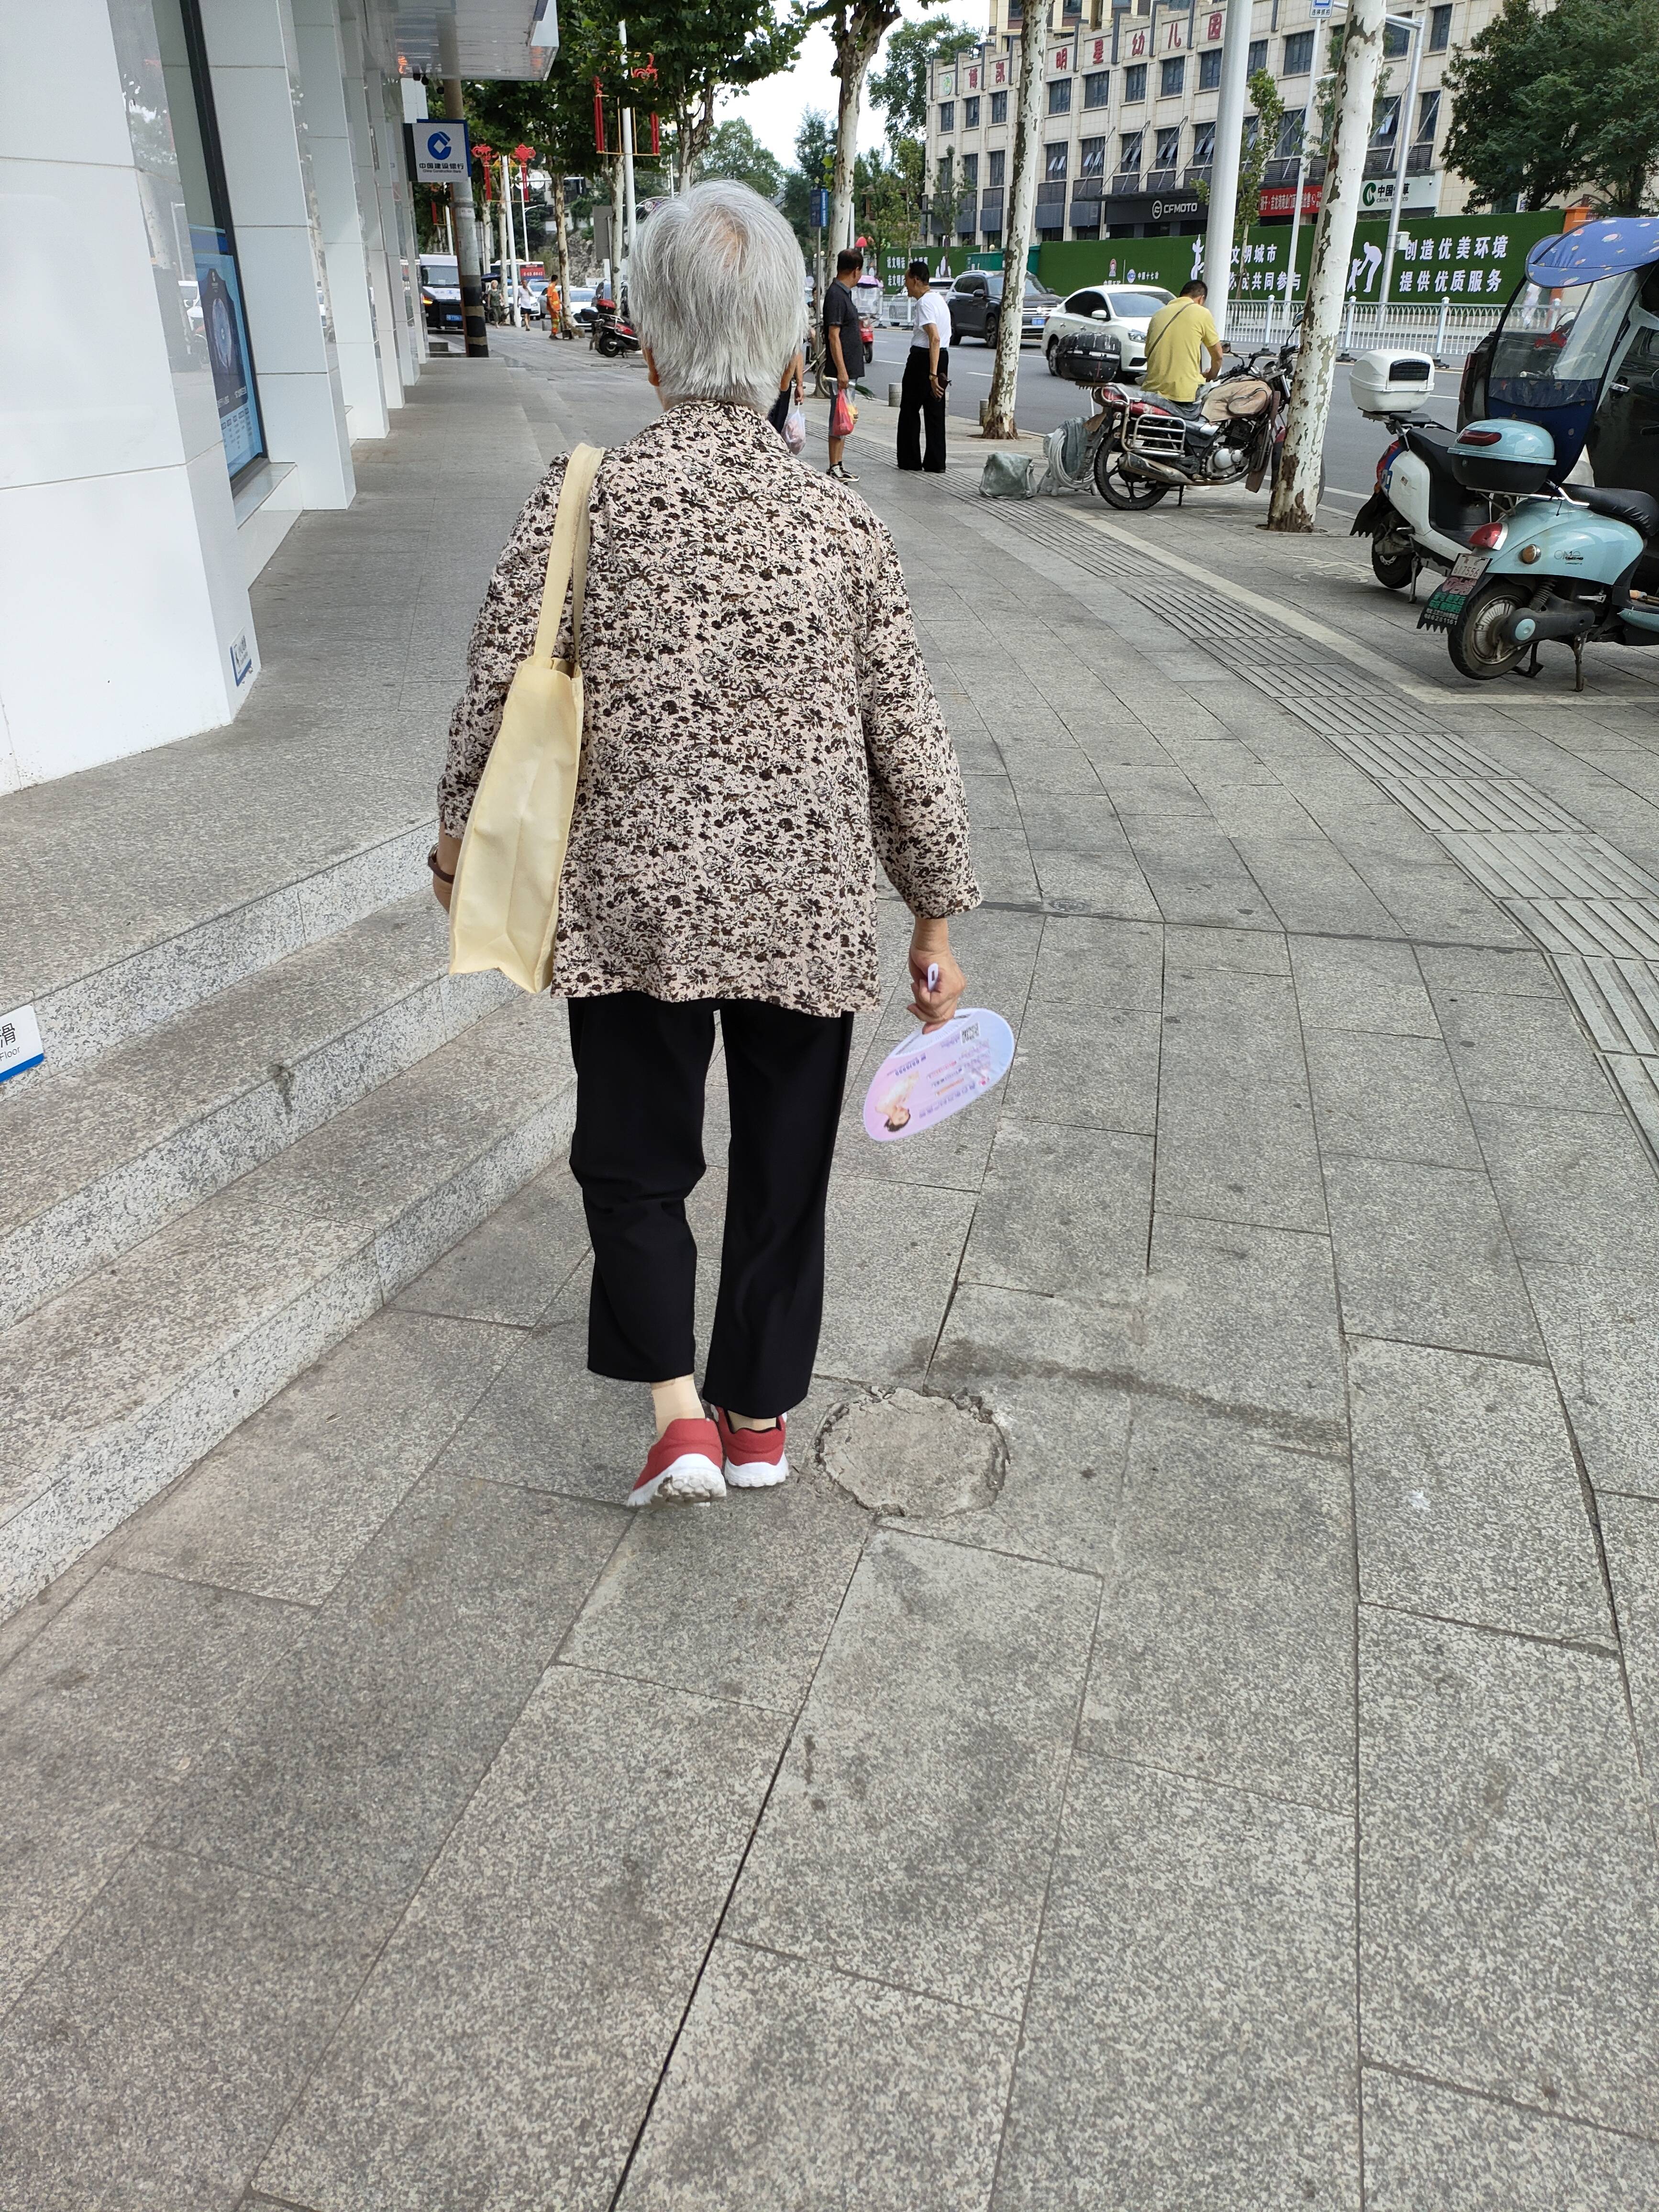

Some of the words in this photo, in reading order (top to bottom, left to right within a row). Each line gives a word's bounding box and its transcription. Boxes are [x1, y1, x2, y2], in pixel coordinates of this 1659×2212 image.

[1377, 183, 1410, 197] 中国草
[1163, 202, 1198, 213] CFMOTO
[1405, 235, 1508, 261] 创造优美环境
[1399, 268, 1502, 292] 提供优质服务
[0, 1046, 21, 1062] Floor
